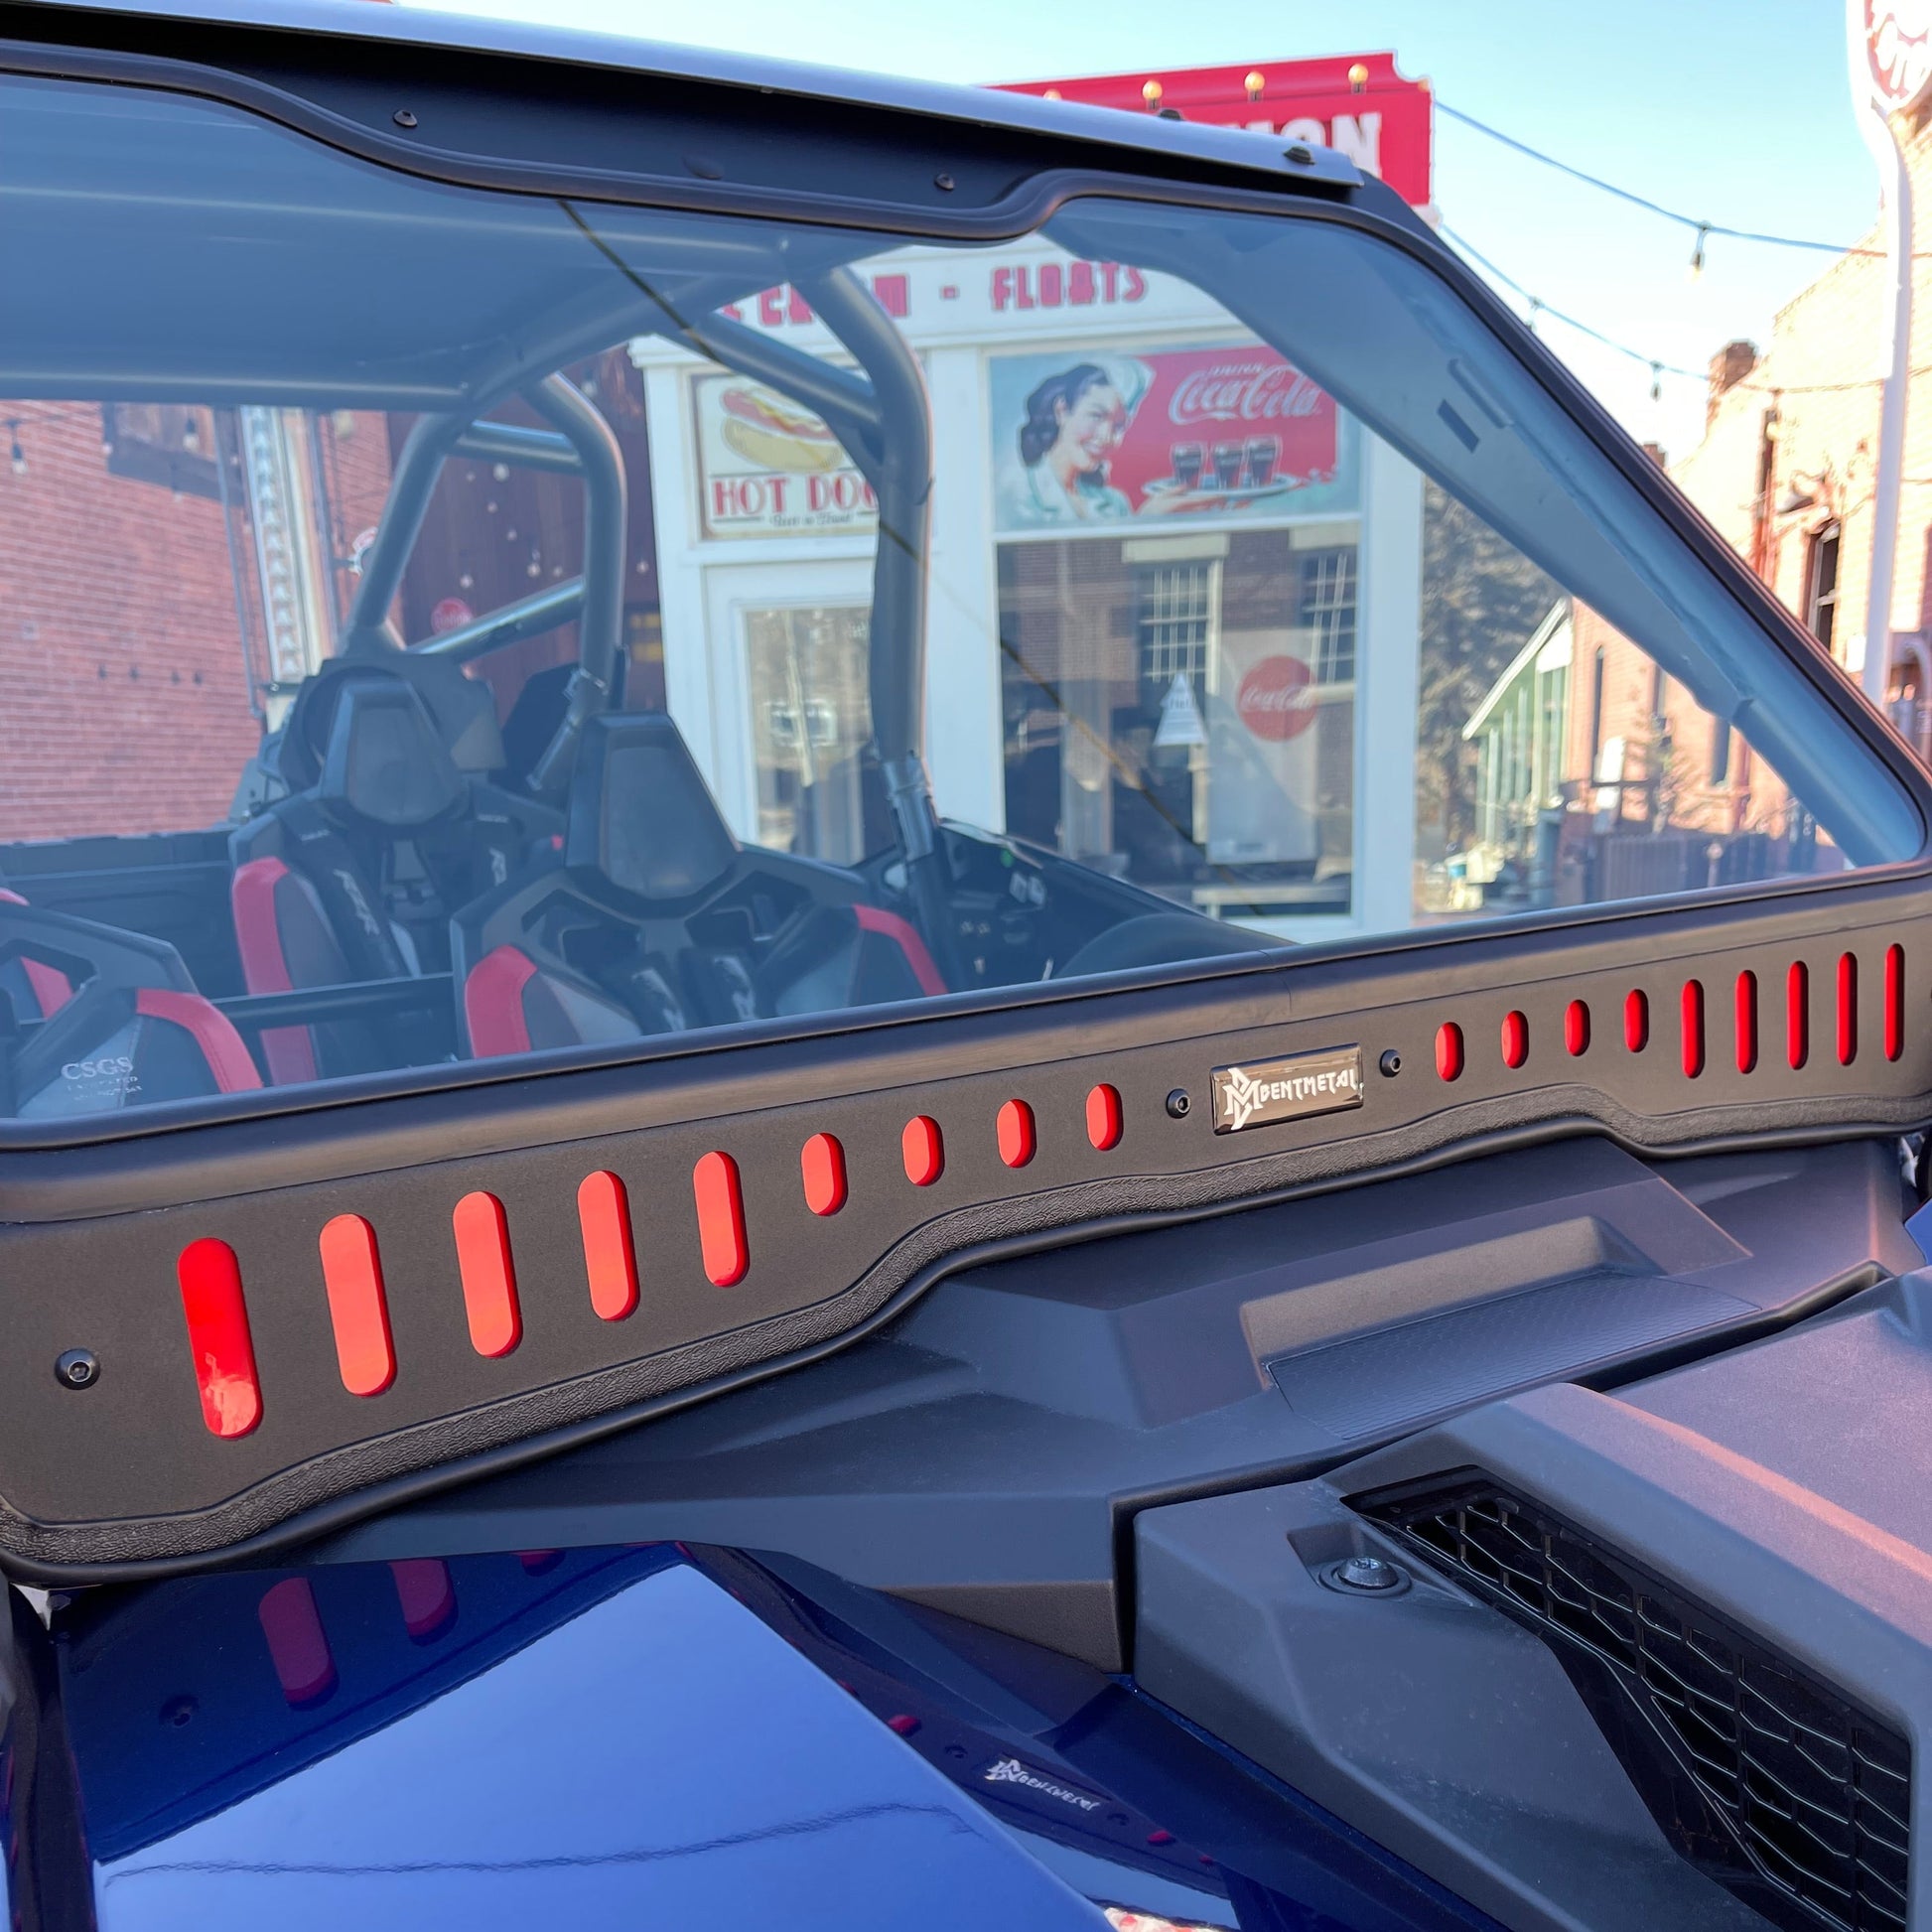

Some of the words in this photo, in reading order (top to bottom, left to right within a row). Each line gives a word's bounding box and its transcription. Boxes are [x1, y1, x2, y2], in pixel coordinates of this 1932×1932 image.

[993, 261, 1148, 310] FLOATS
[713, 478, 789, 516] HOT
[61, 1056, 133, 1080] CSGS
